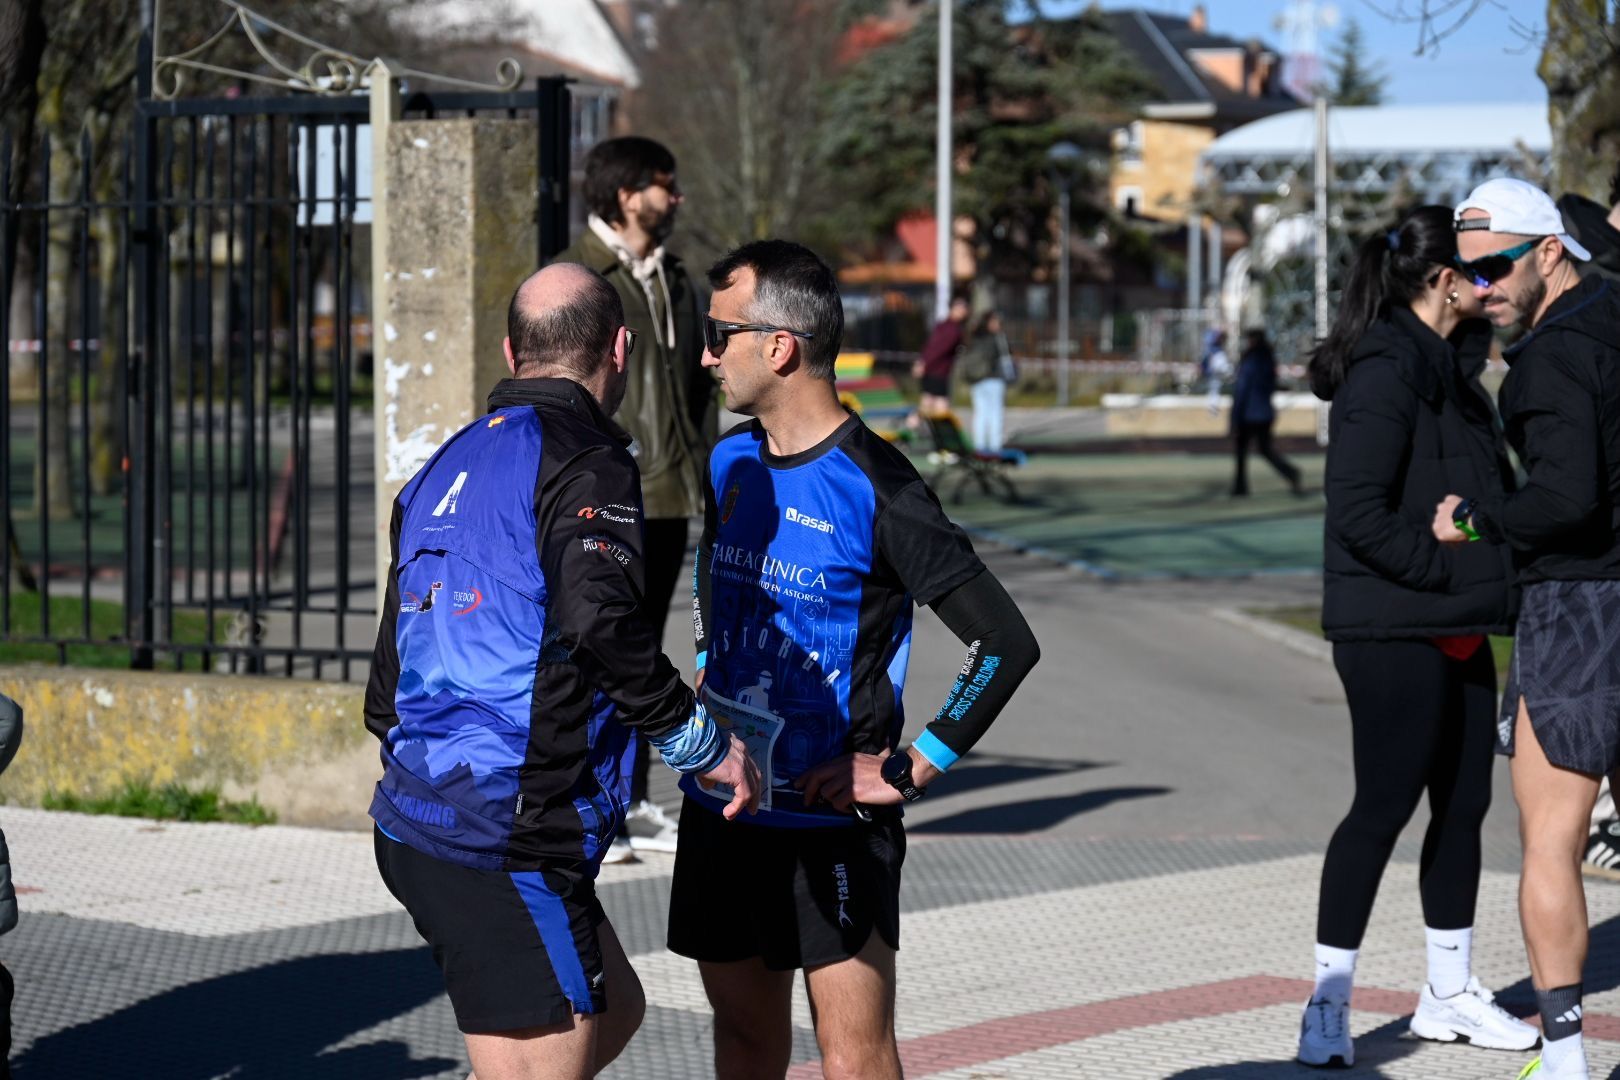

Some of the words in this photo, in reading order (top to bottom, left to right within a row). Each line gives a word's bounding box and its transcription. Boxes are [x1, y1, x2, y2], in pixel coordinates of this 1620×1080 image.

[600, 510, 636, 524] Ventura
[771, 583, 781, 593] EN
[782, 587, 824, 604] ASTORGA
[948, 697, 972, 721] CROSS
[972, 655, 1002, 687] COLOMBA
